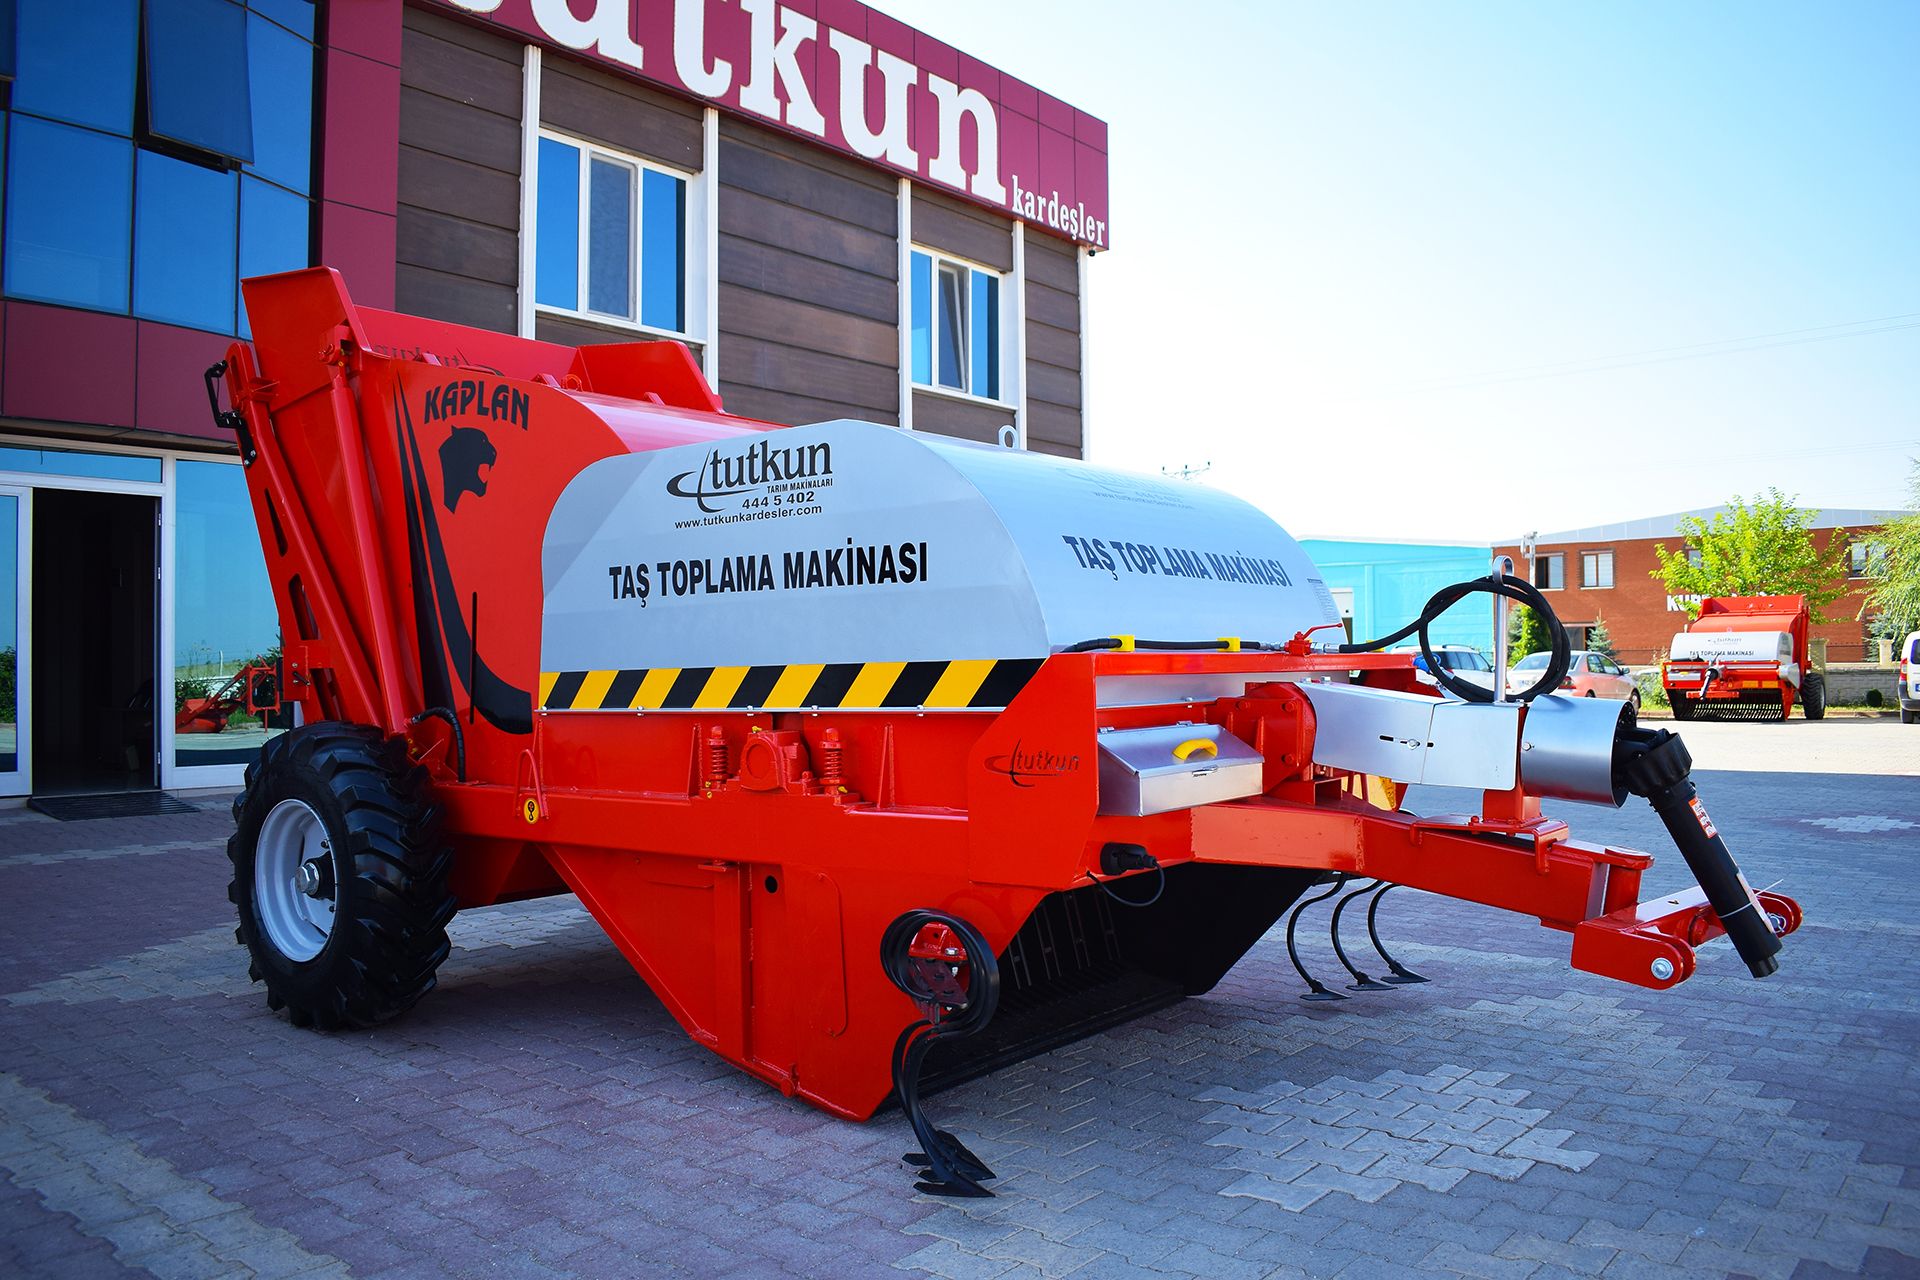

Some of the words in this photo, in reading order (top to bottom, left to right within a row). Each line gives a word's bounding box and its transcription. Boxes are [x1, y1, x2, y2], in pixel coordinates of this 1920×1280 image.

[1012, 174, 1105, 246] kardeşler
[424, 380, 529, 431] KAPLAN
[710, 440, 833, 489] tutkun
[767, 484, 789, 494] TARIM
[789, 478, 833, 492] MAKİNALARI
[674, 504, 822, 529] www.tutkunkardesler.com
[742, 495, 769, 509] 444
[773, 494, 782, 505] 5
[786, 490, 815, 505] 402
[609, 563, 650, 608] TAŞ
[657, 554, 776, 597] TOPLAMA
[783, 537, 928, 590] MAKİNASI
[1062, 535, 1119, 581] TAŞ
[1109, 540, 1213, 580] TOPLAMA
[1204, 550, 1293, 587] MAKİNASI
[1016, 750, 1080, 771] tutkun
